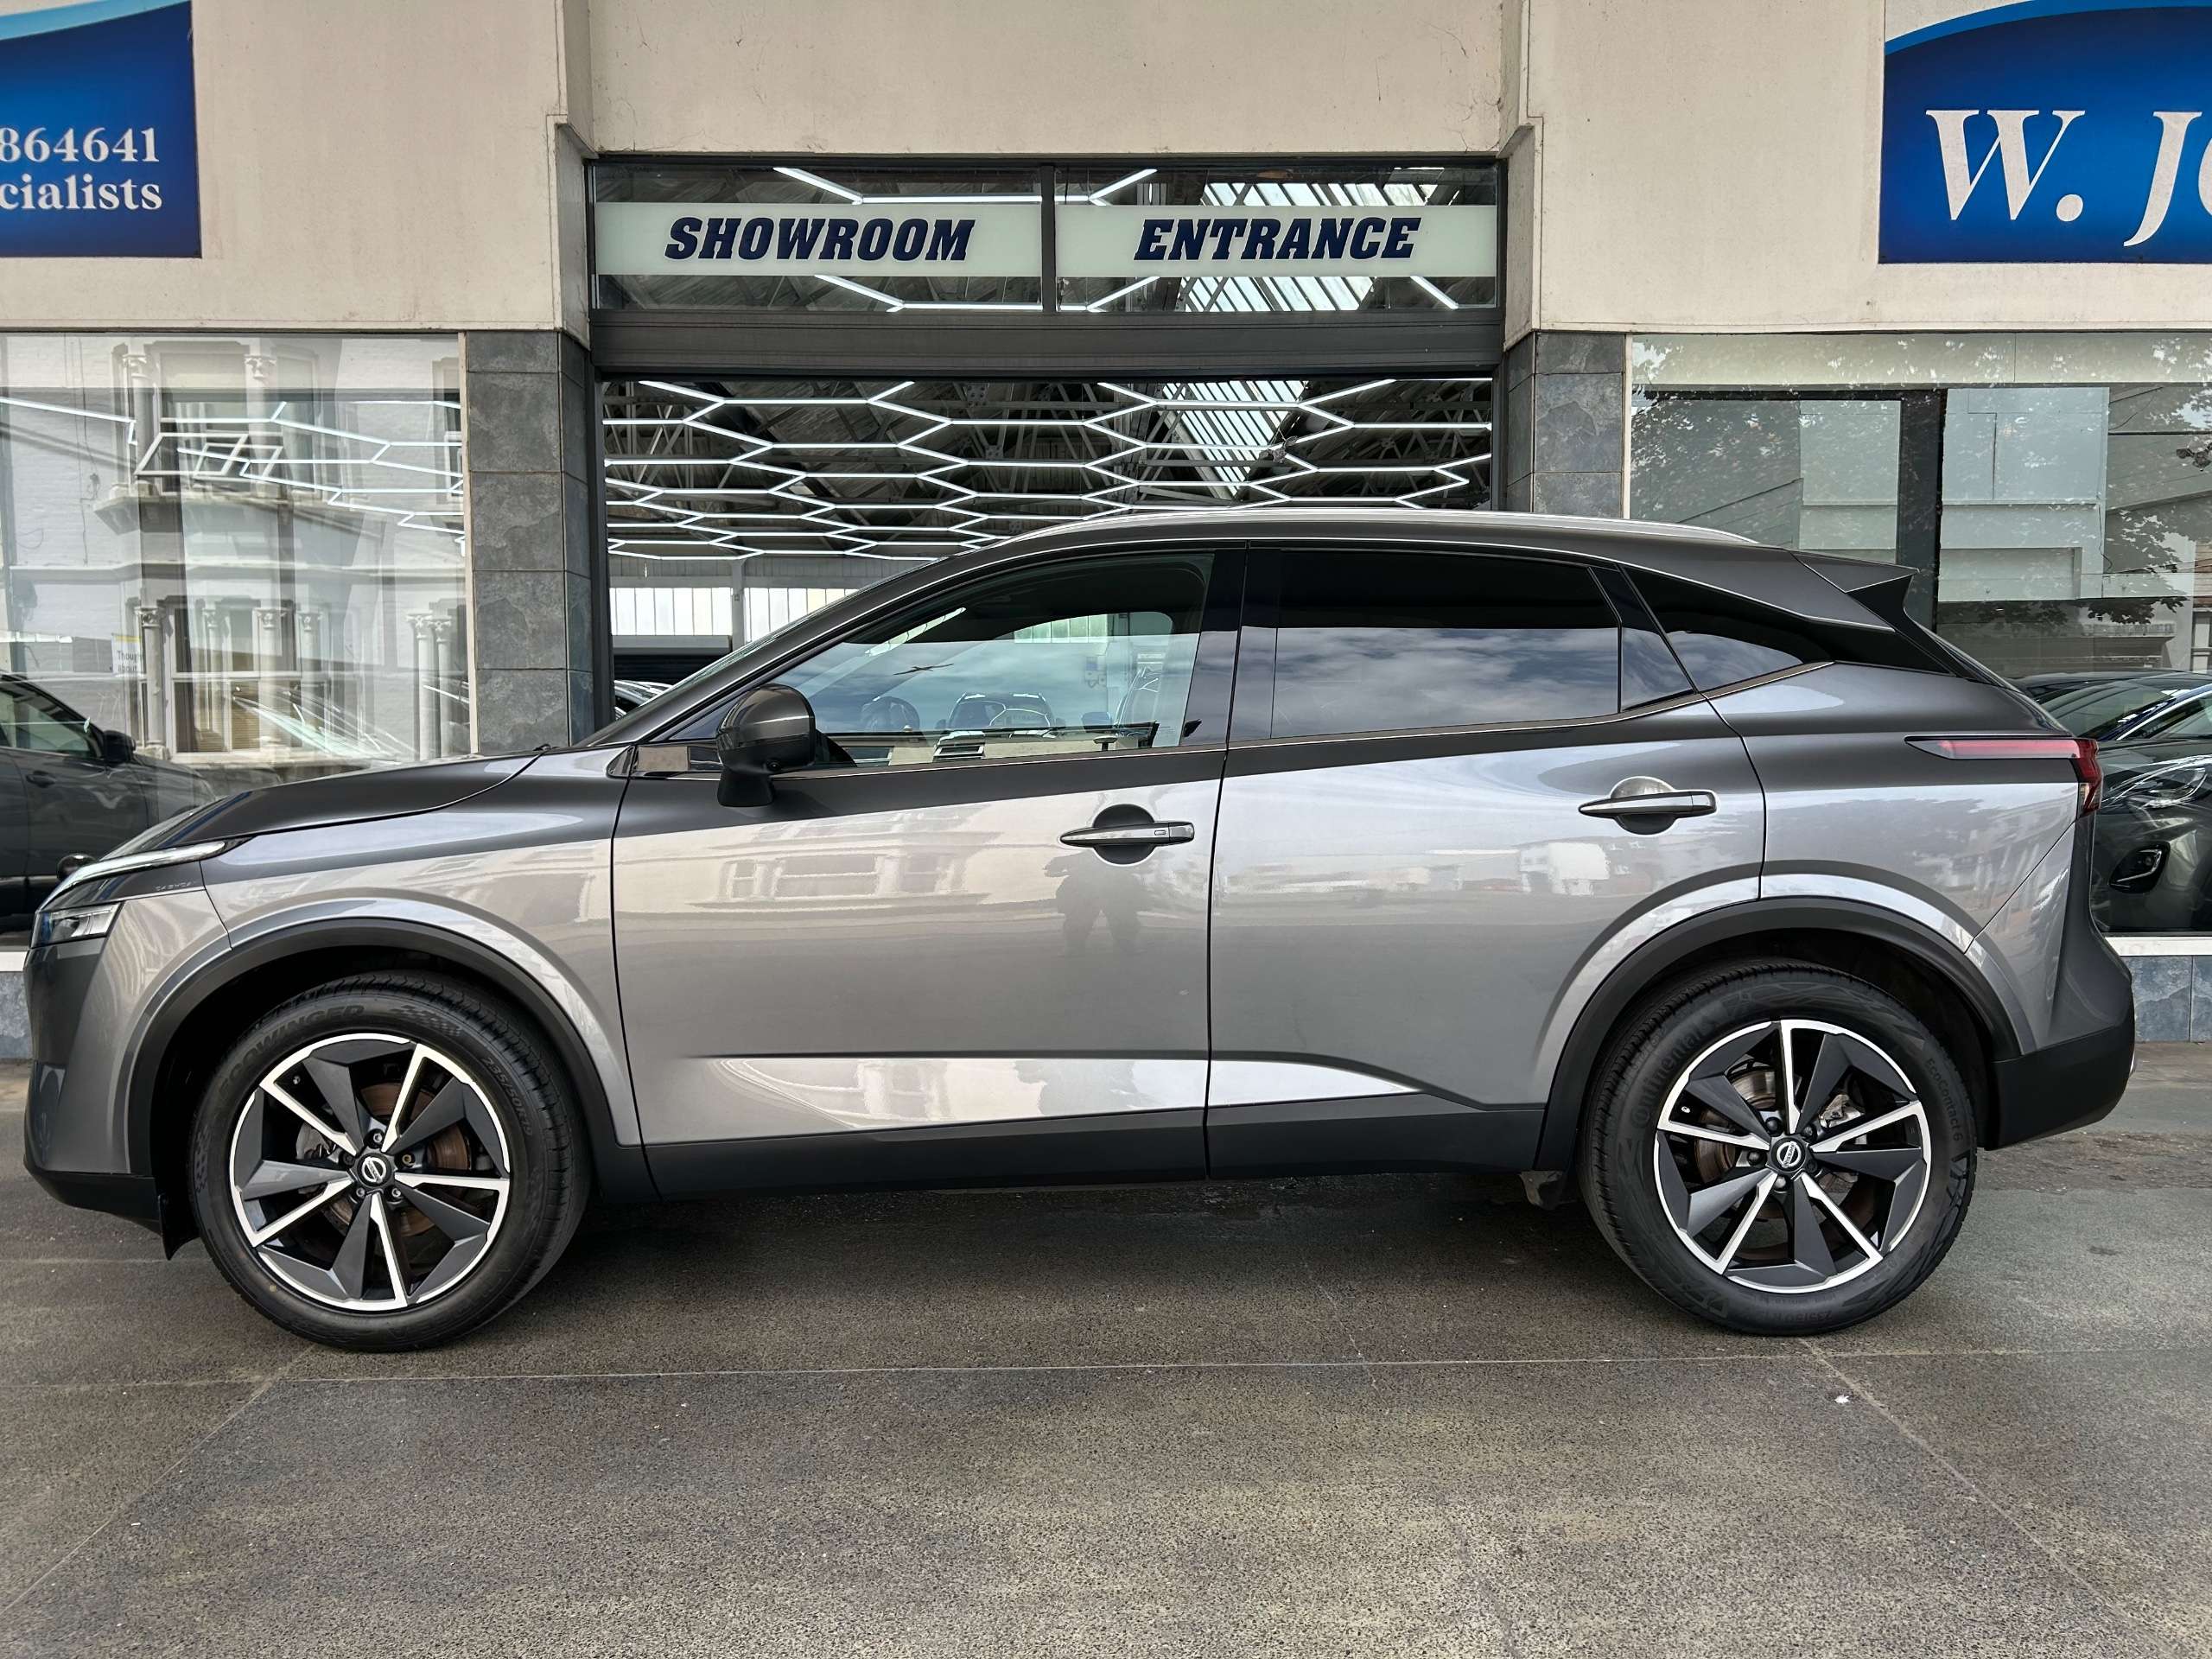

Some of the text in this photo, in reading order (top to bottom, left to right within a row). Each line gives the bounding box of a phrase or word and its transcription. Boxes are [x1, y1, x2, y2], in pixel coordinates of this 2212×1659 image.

[0, 128, 159, 162] 864641
[0, 174, 162, 209] cialists
[1926, 111, 2212, 246] W. J
[664, 217, 976, 261] SHOWROOM
[1134, 217, 1421, 260] ENTRANCE
[1630, 1026, 1704, 1128] Continental
[1924, 1057, 1961, 1130] EcoContact
